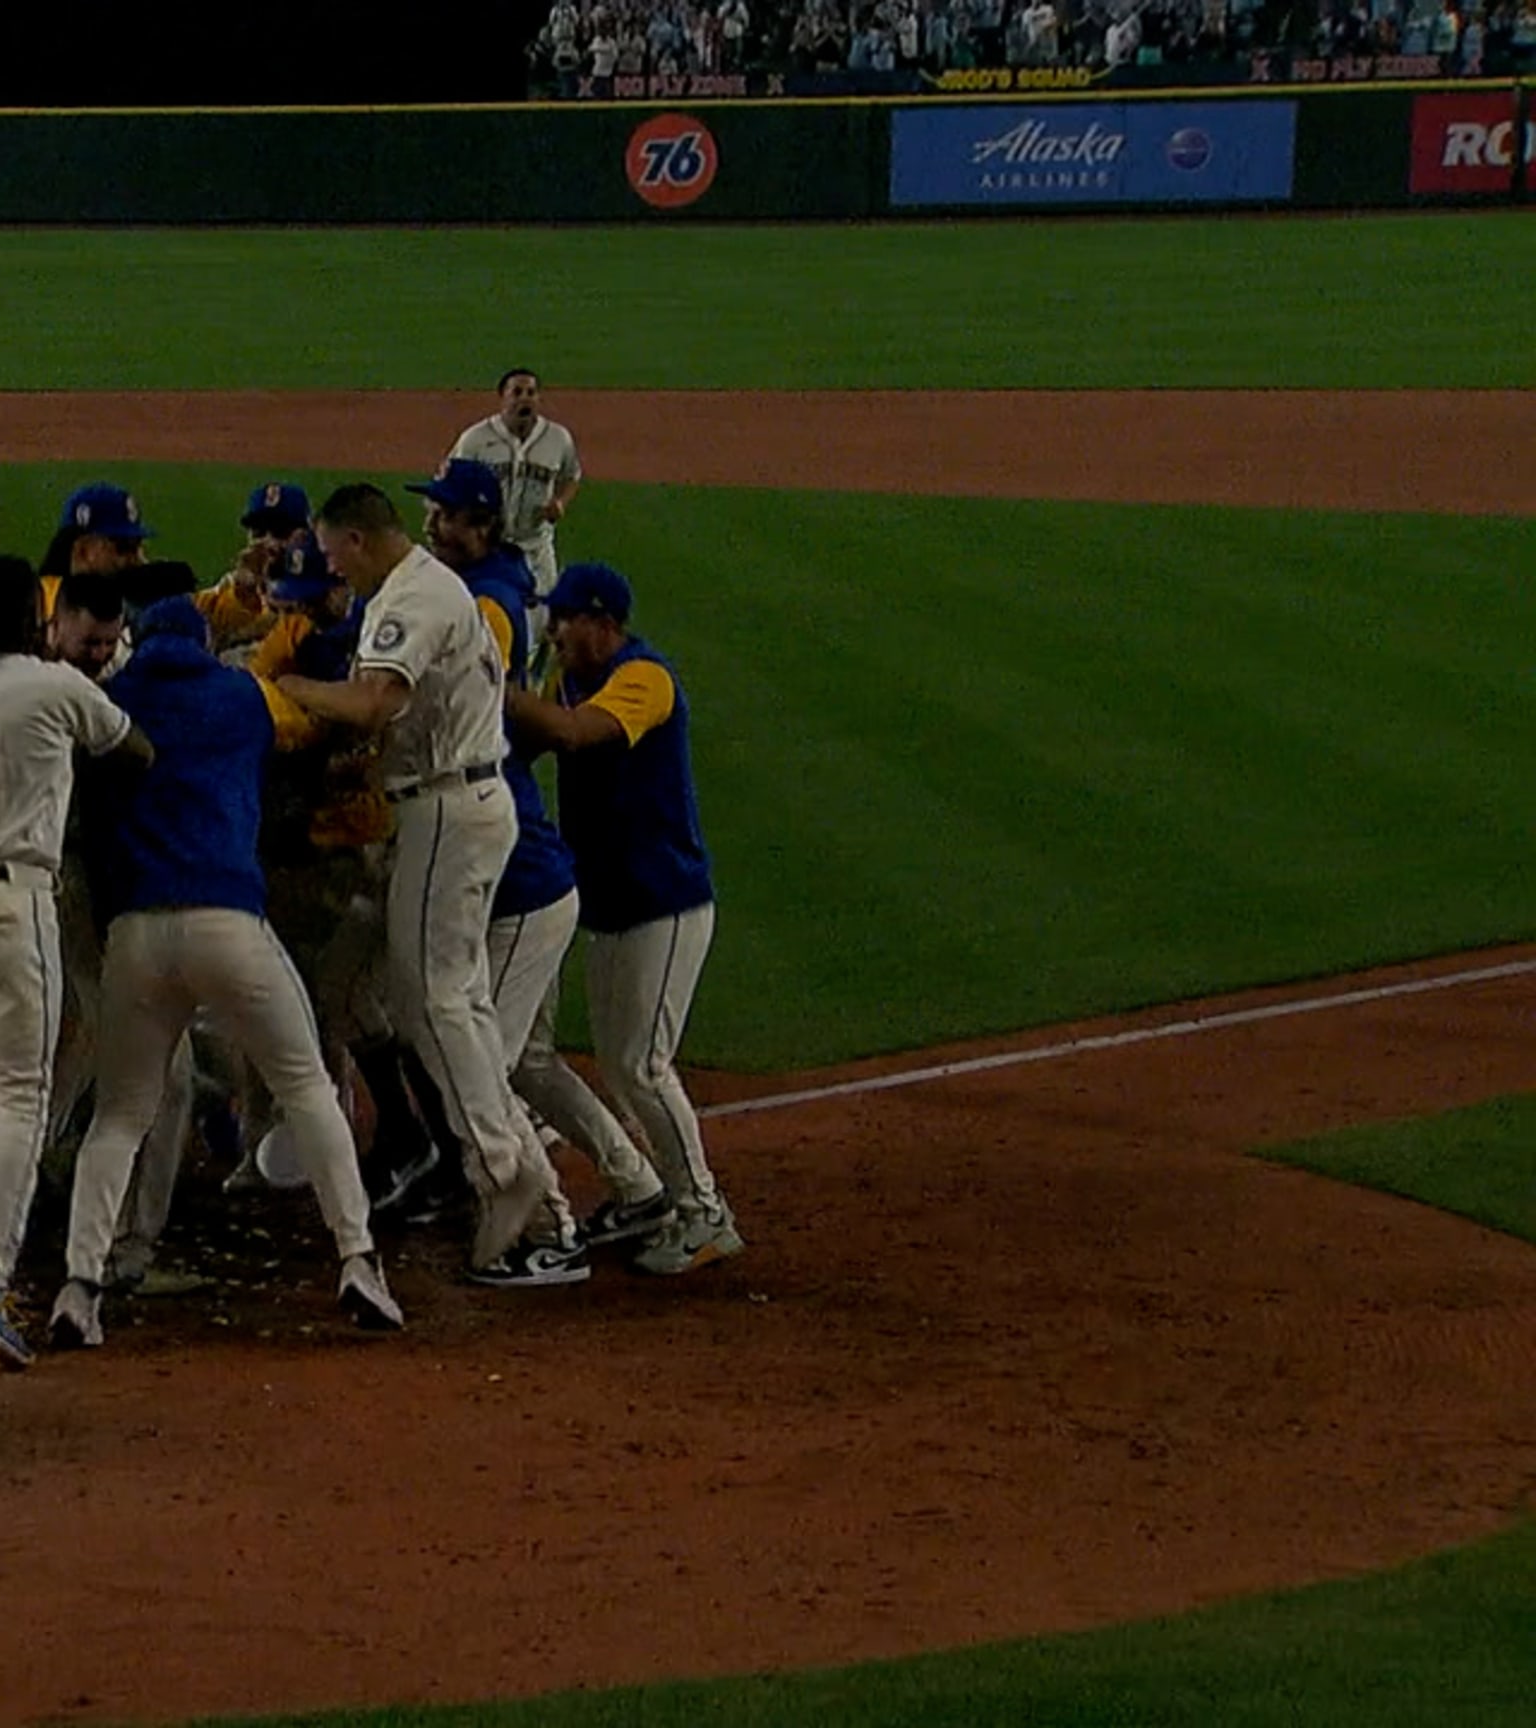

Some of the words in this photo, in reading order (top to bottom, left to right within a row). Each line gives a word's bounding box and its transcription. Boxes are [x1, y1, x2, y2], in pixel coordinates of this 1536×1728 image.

[638, 131, 706, 188] 76
[972, 119, 1124, 166] Alaska
[979, 170, 1110, 188] AIRLINES
